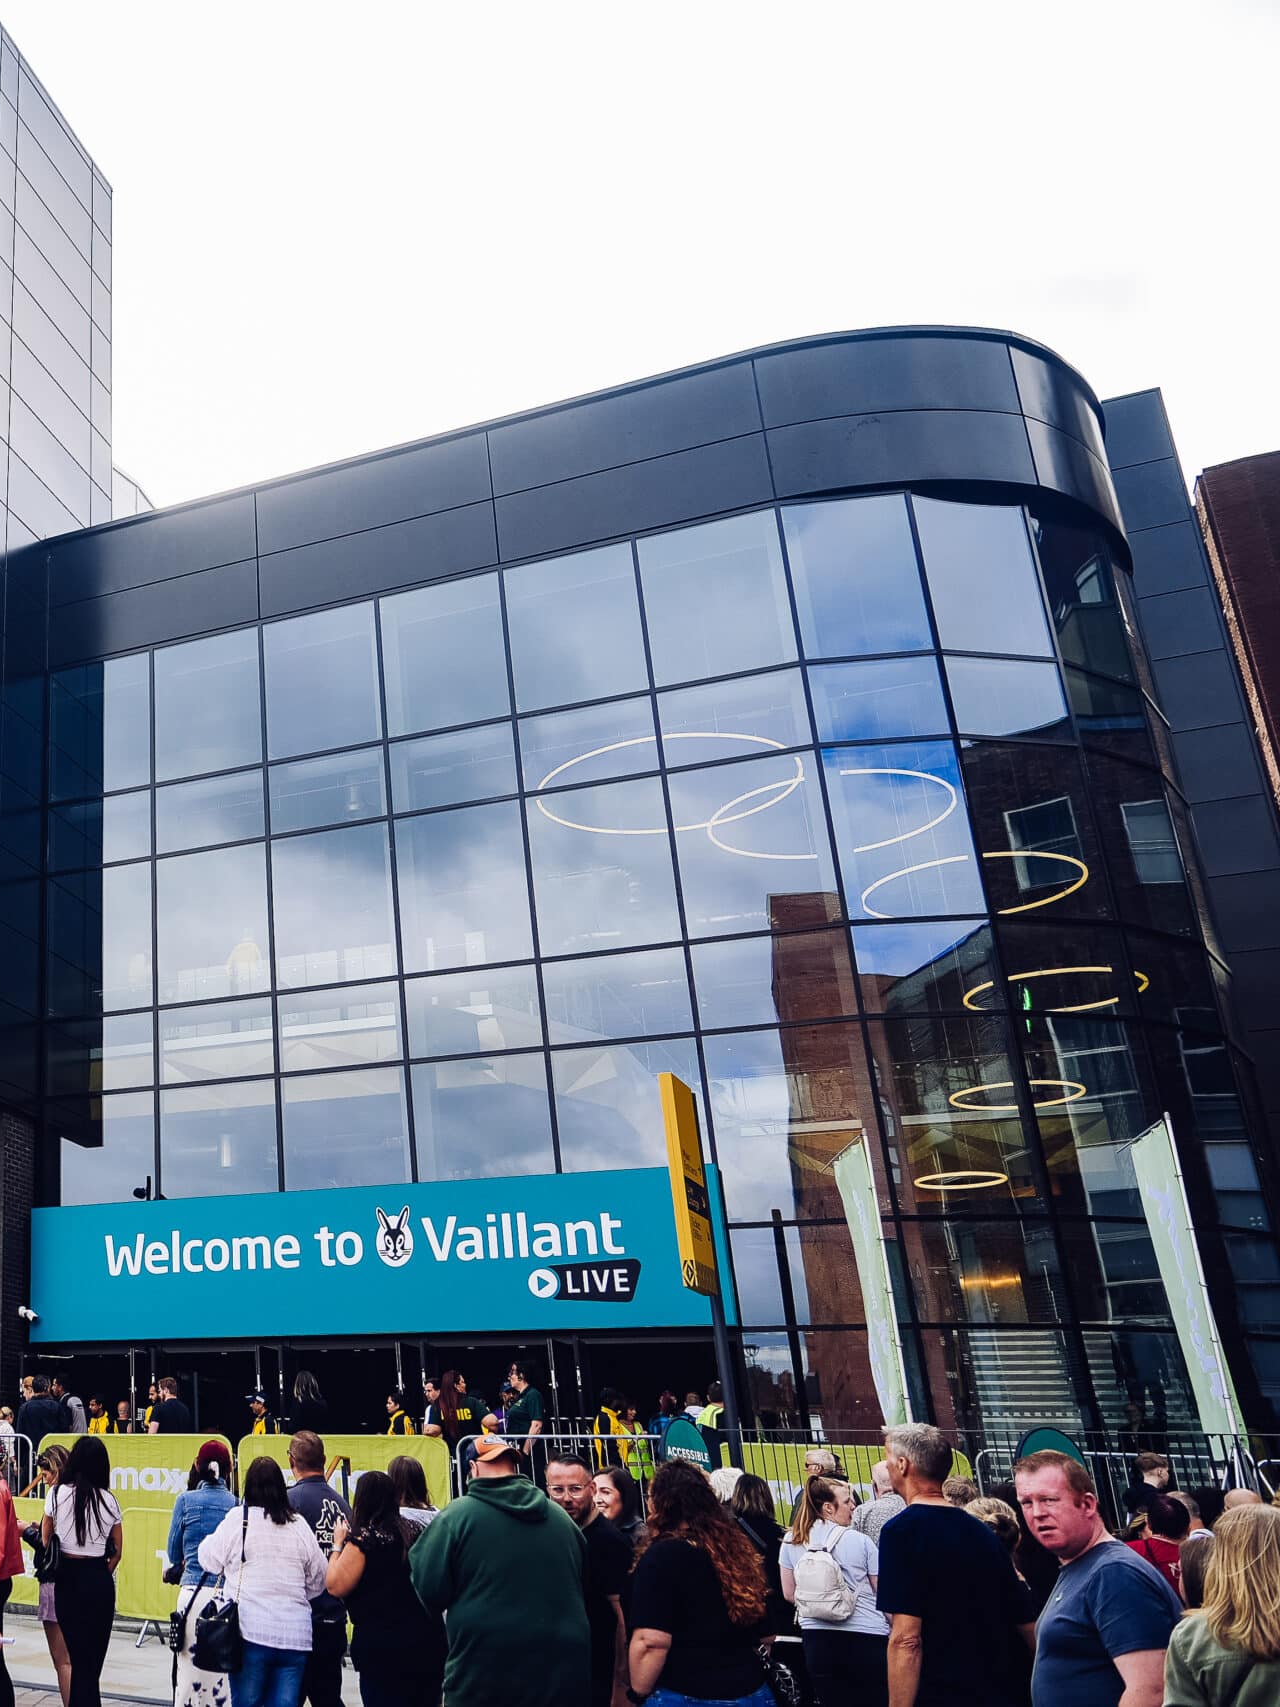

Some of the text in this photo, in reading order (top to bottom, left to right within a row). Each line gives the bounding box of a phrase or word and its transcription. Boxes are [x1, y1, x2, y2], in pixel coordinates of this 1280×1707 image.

[104, 1212, 625, 1277] Welcome to Vaillant
[565, 1268, 630, 1294] LIVE
[667, 1446, 710, 1462] ACCESSIBLE
